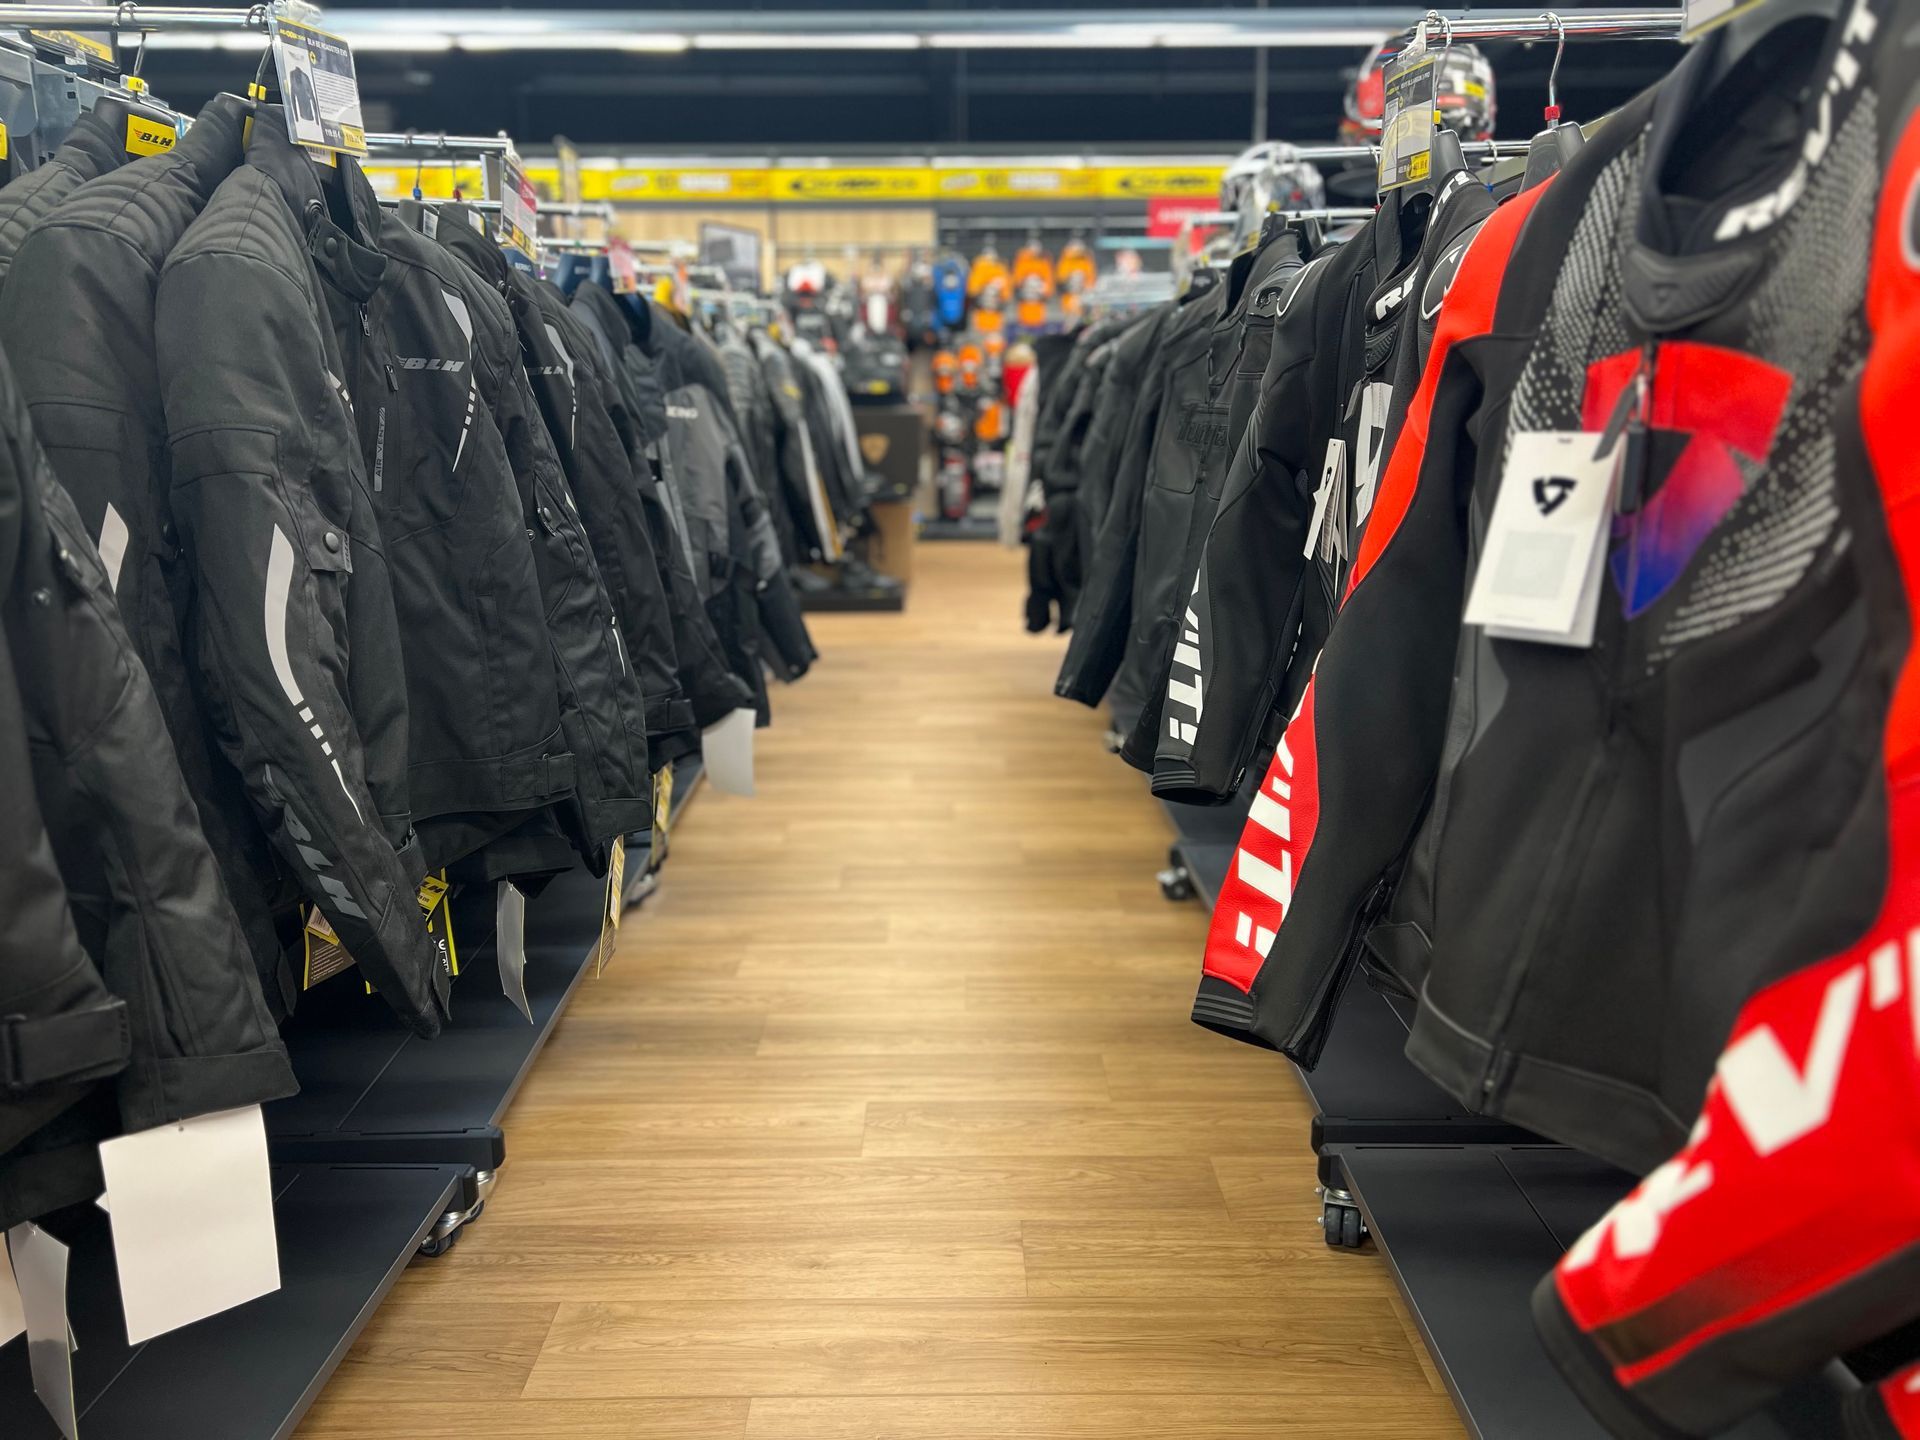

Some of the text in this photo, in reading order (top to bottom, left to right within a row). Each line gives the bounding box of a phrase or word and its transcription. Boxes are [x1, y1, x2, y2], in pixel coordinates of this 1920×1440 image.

[140, 132, 172, 147] BLH
[402, 358, 465, 372] BLH
[375, 422, 385, 477] AIR VENT
[284, 802, 368, 919] BLH
